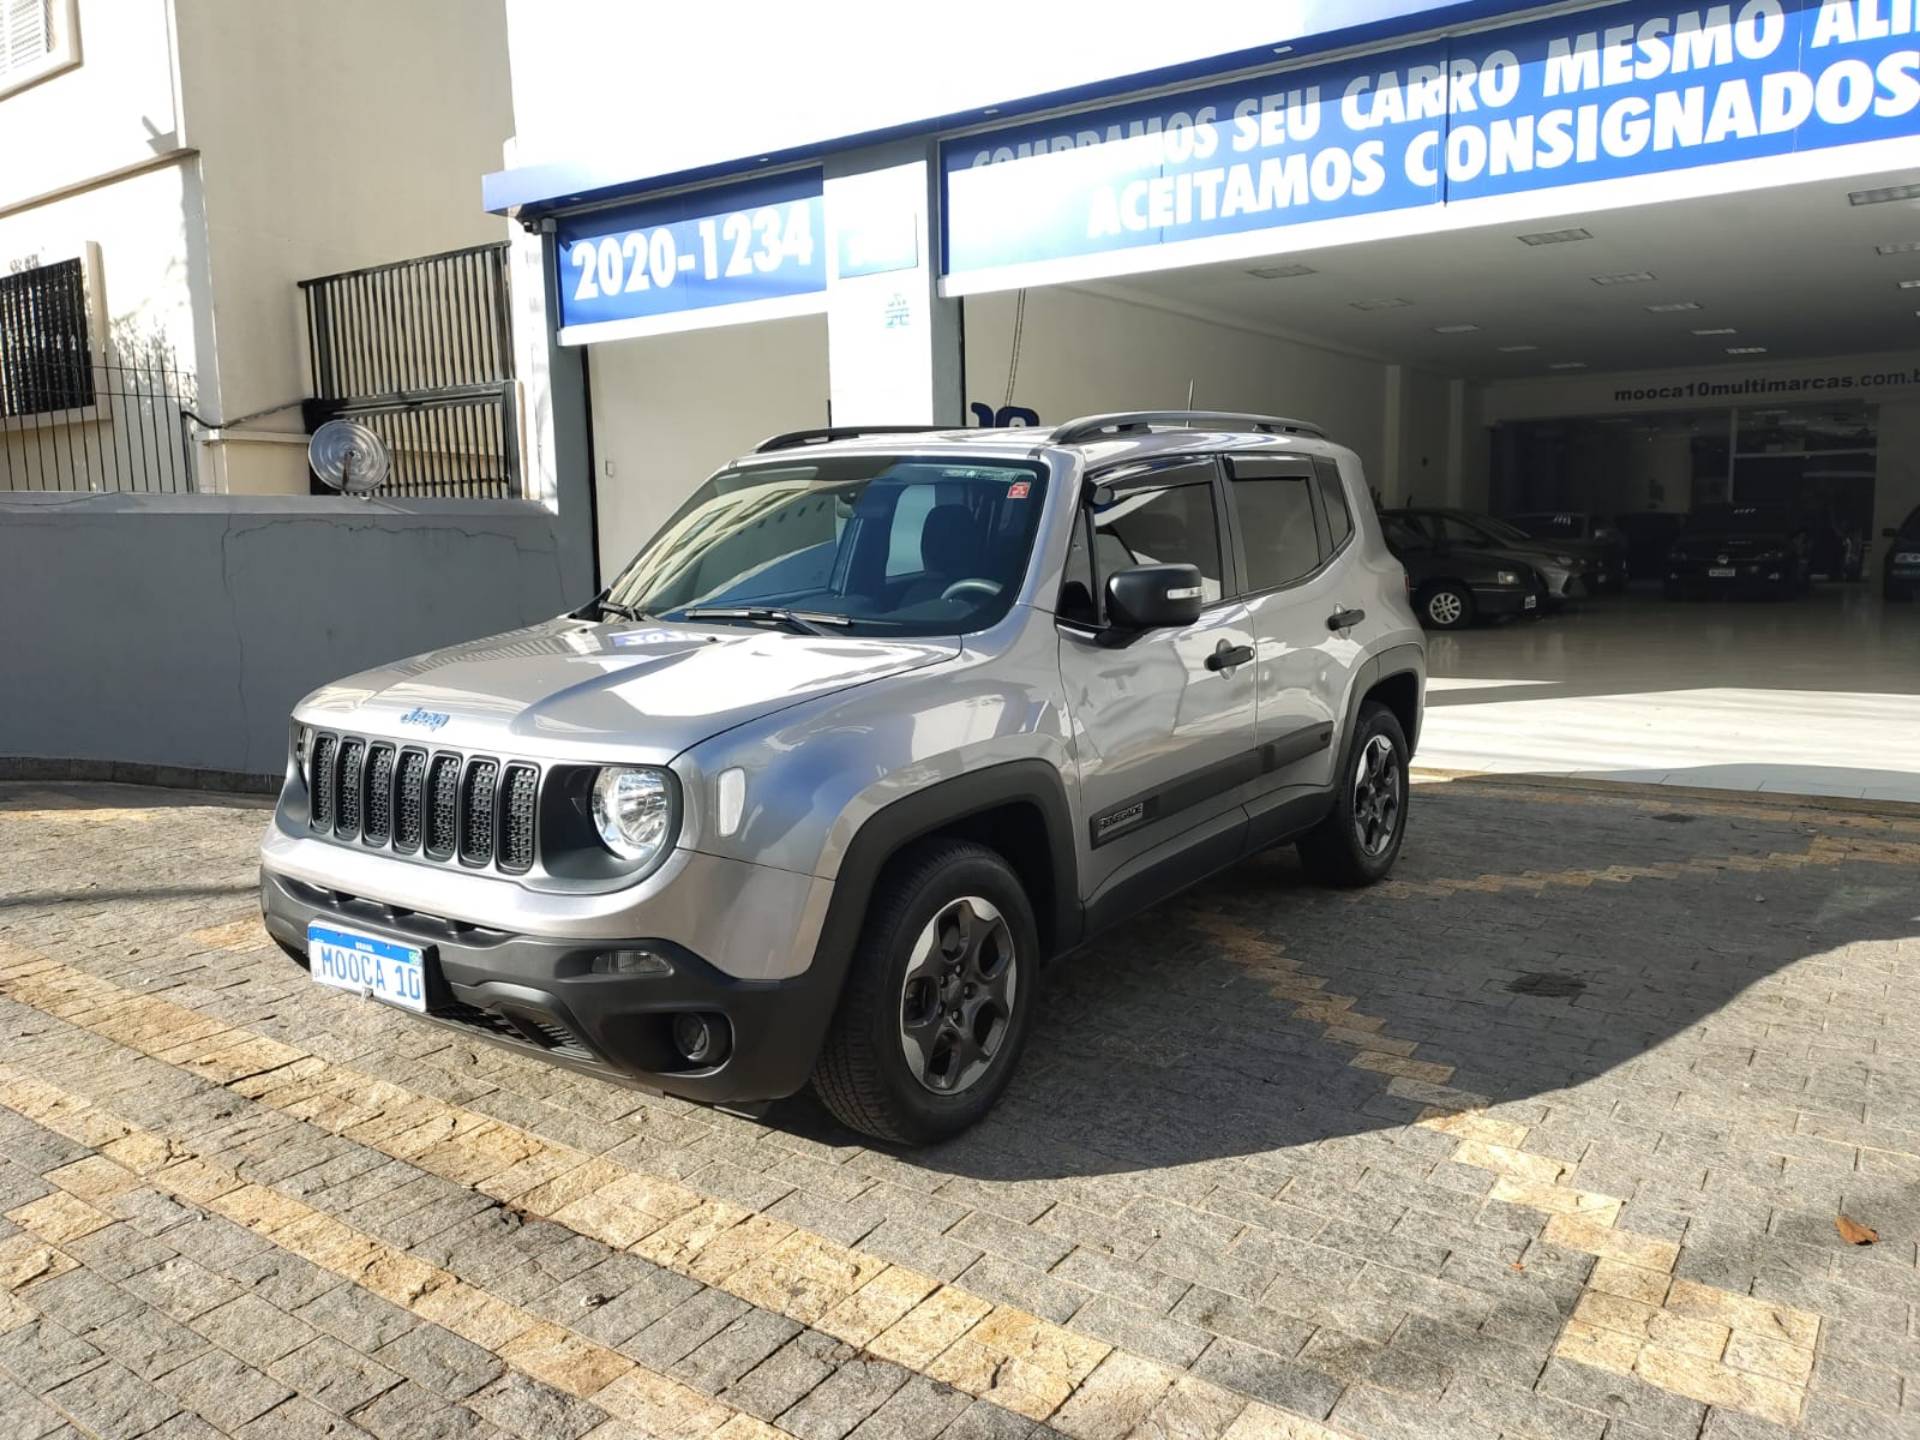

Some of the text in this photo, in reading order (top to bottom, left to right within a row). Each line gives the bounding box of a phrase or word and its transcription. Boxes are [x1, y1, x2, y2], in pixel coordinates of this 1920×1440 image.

[1232, 0, 1920, 152] SEU CARRO MESMO ALI
[1087, 140, 1386, 238] ACEITAMOS
[1404, 50, 1920, 187] CONSIGNADOS
[571, 201, 814, 301] 2020-1234
[320, 946, 386, 991] MOOCA
